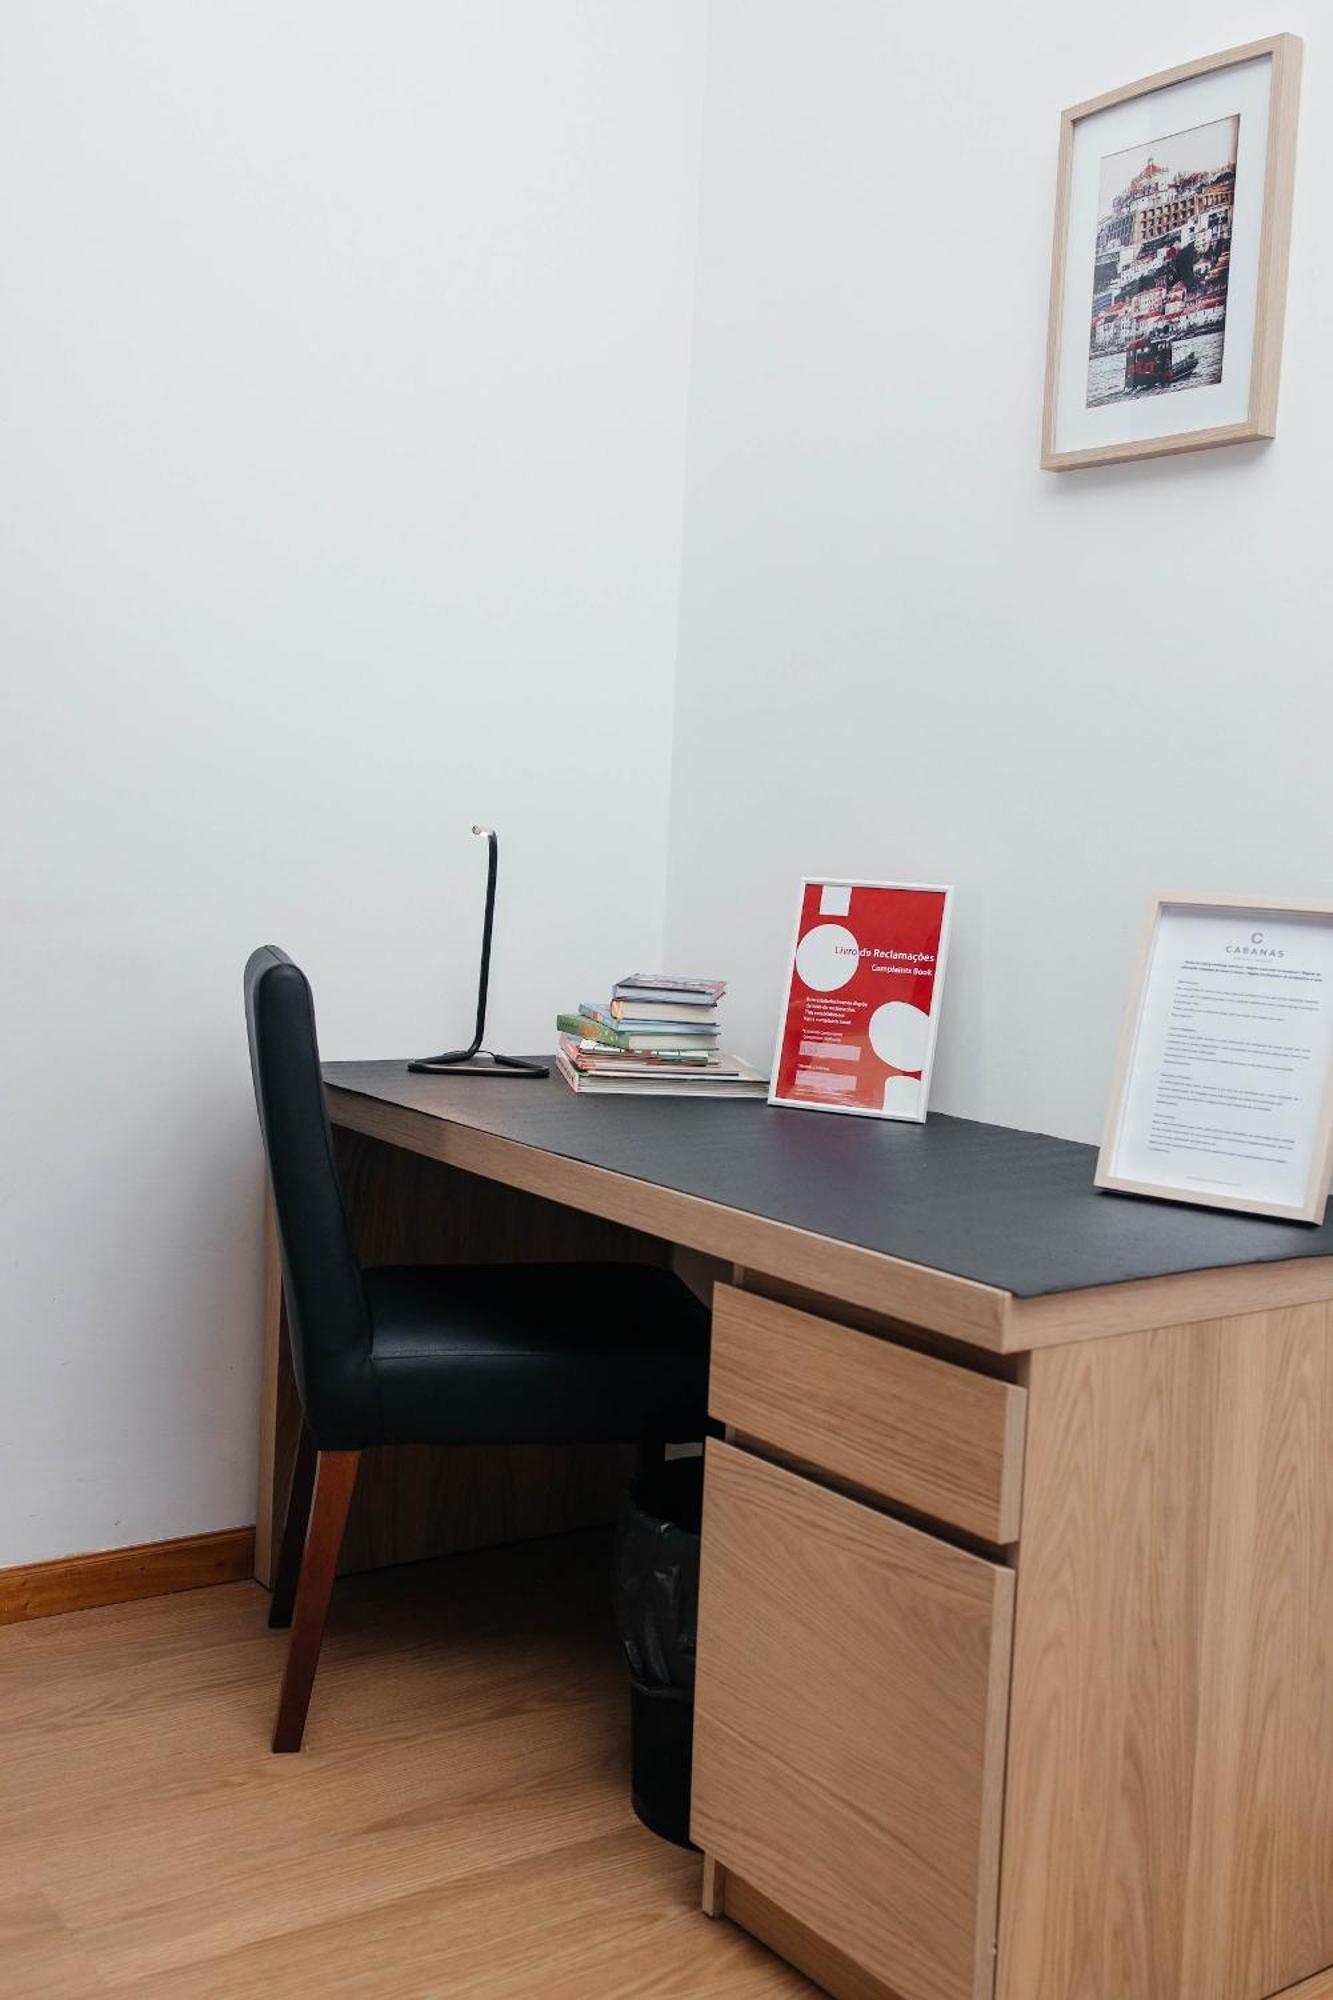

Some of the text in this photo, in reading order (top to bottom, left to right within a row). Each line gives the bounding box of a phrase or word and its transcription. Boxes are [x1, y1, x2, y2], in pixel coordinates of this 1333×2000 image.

[1251, 932, 1264, 944] C
[834, 945, 857, 956] Livro
[874, 948, 935, 963] Reclamações
[1225, 945, 1285, 958] CABANAS
[871, 964, 933, 976] Complaints Book
